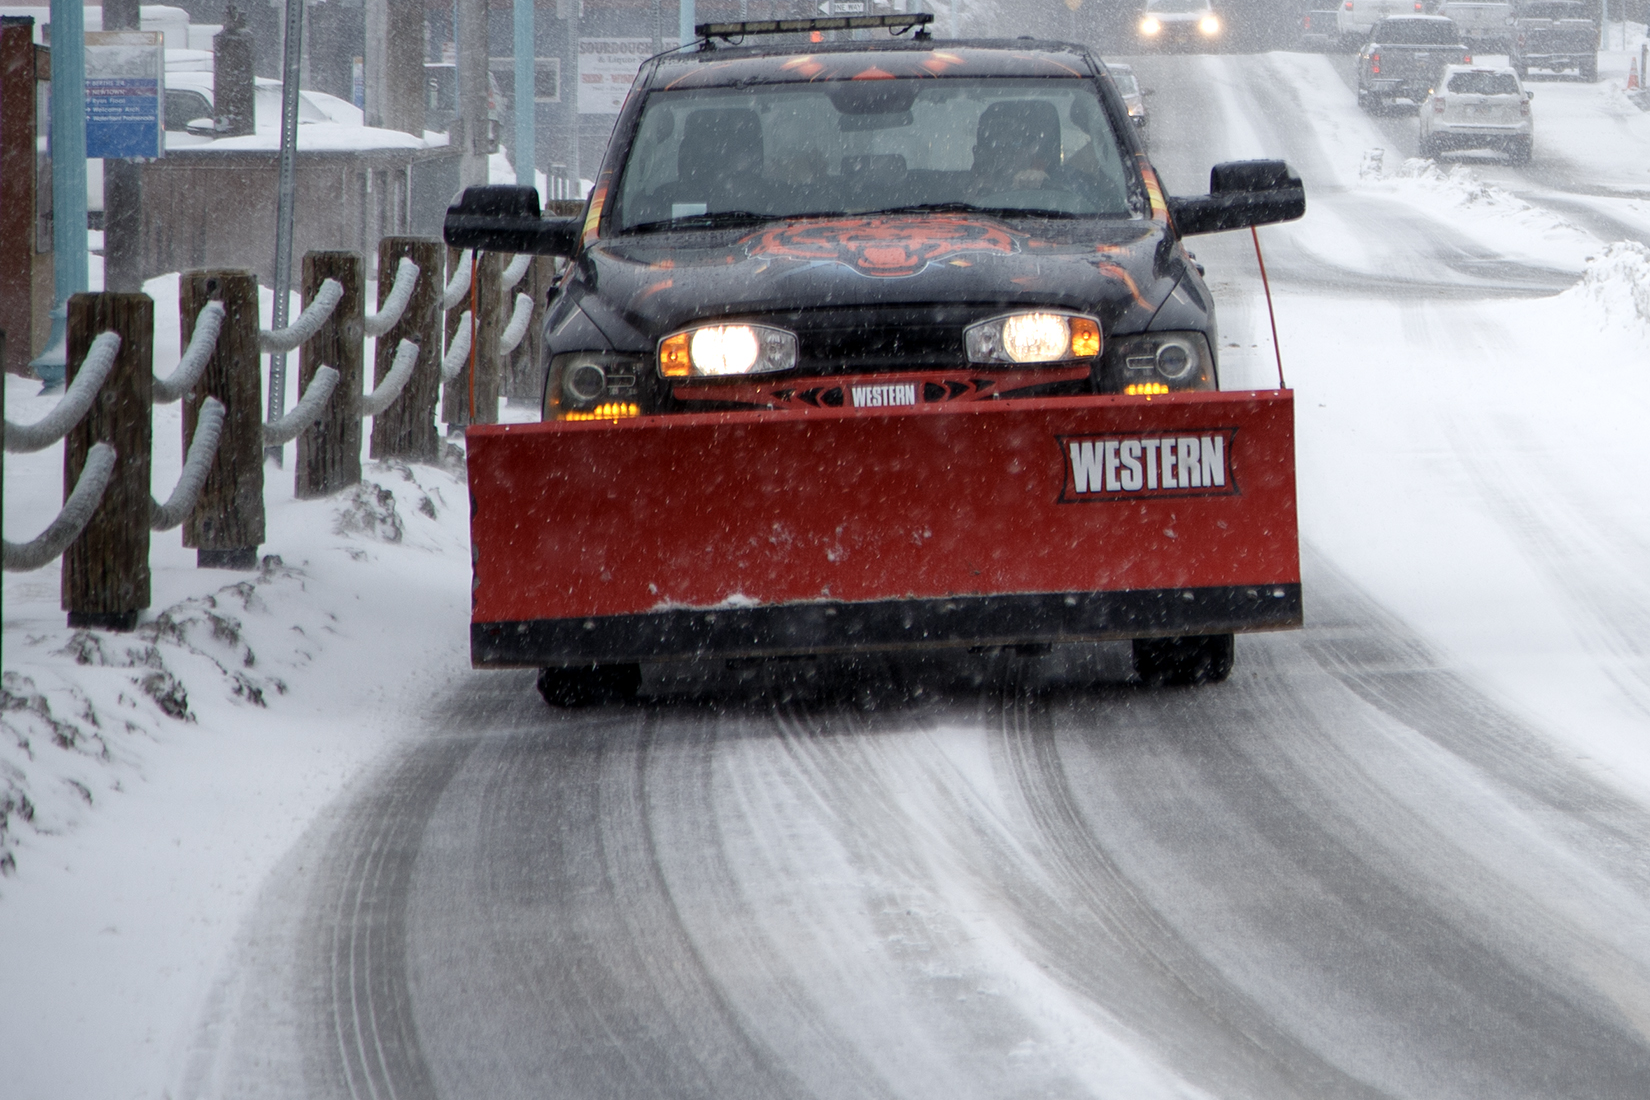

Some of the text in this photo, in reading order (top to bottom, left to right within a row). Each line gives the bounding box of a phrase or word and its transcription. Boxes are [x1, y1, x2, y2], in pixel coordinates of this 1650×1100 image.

[848, 3, 863, 11] WAY
[851, 385, 916, 408] WESTERN
[1070, 436, 1225, 494] WESTERN
